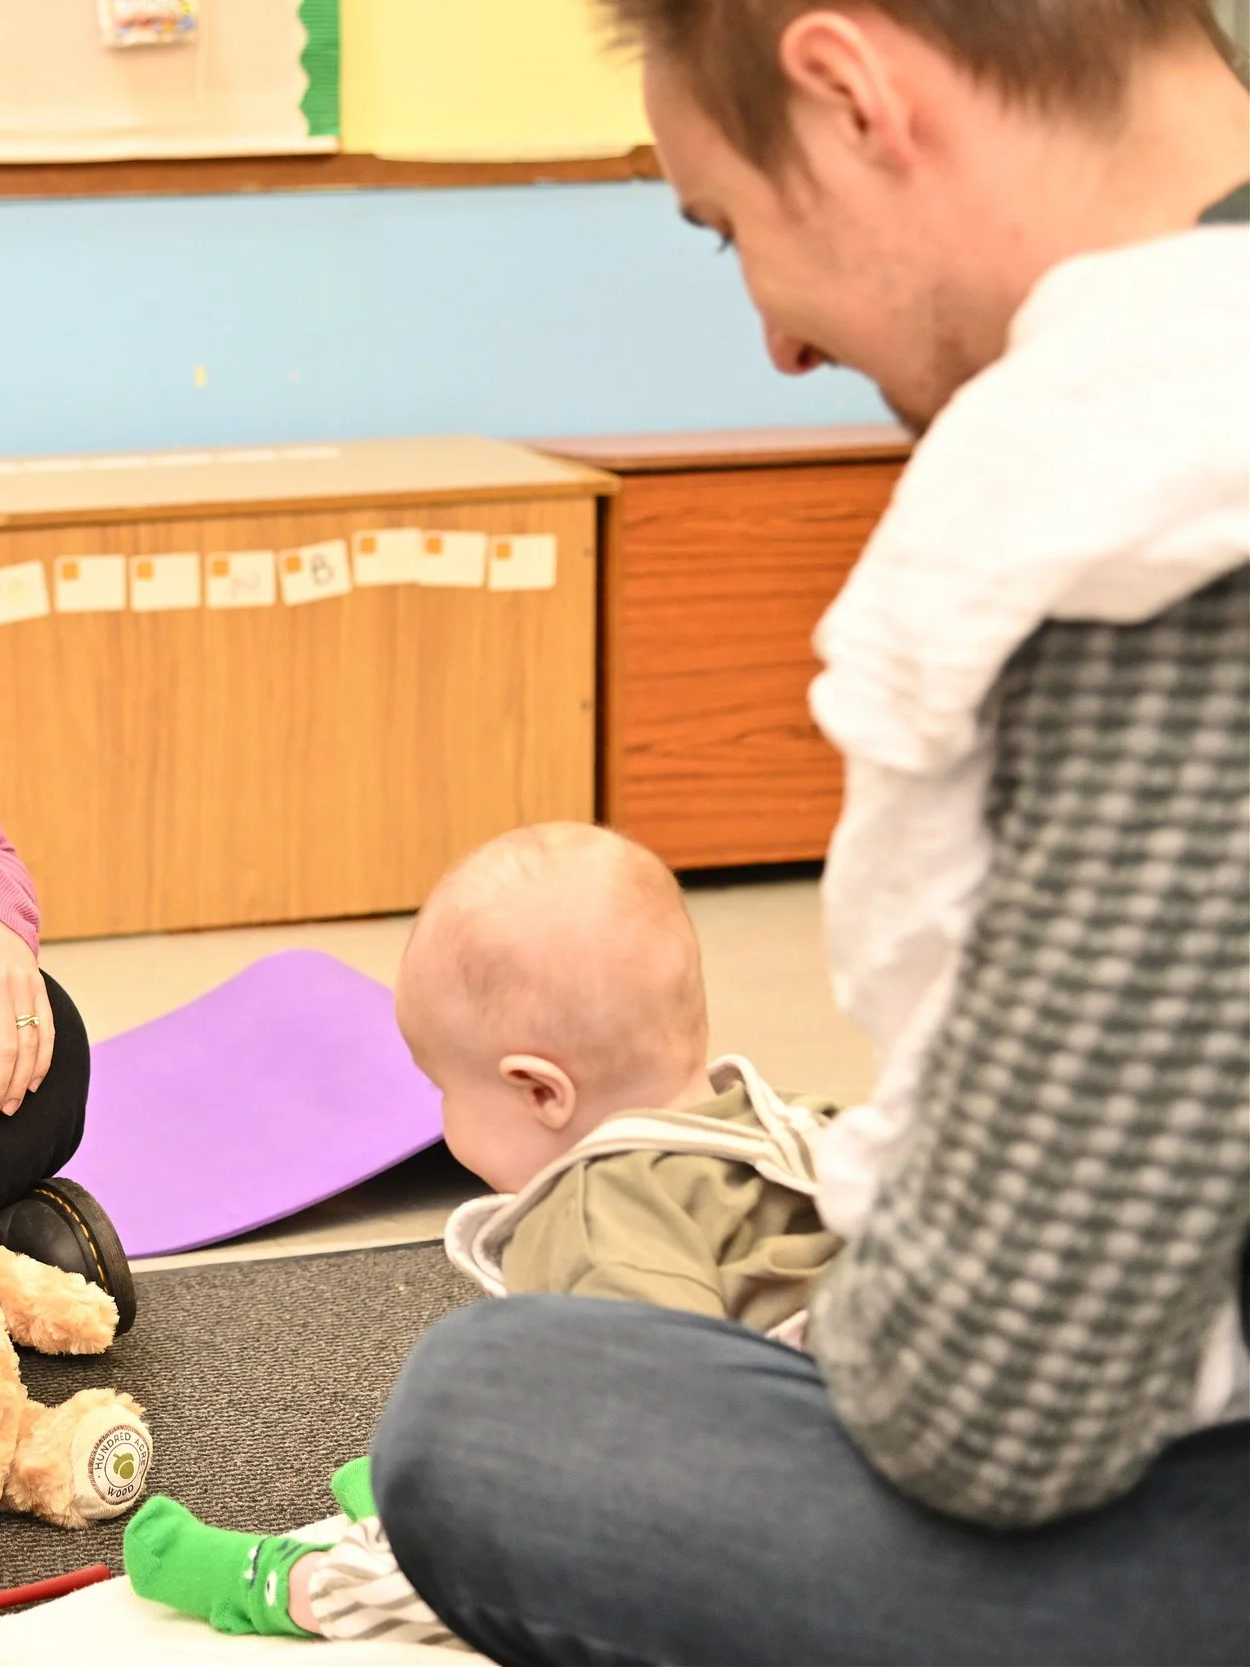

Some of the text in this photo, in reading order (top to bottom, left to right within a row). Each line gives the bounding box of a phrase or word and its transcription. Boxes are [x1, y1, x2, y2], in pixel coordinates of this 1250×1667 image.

[95, 1432, 147, 1470] HUNDRED ACRE
[107, 1484, 134, 1498] WOOD
